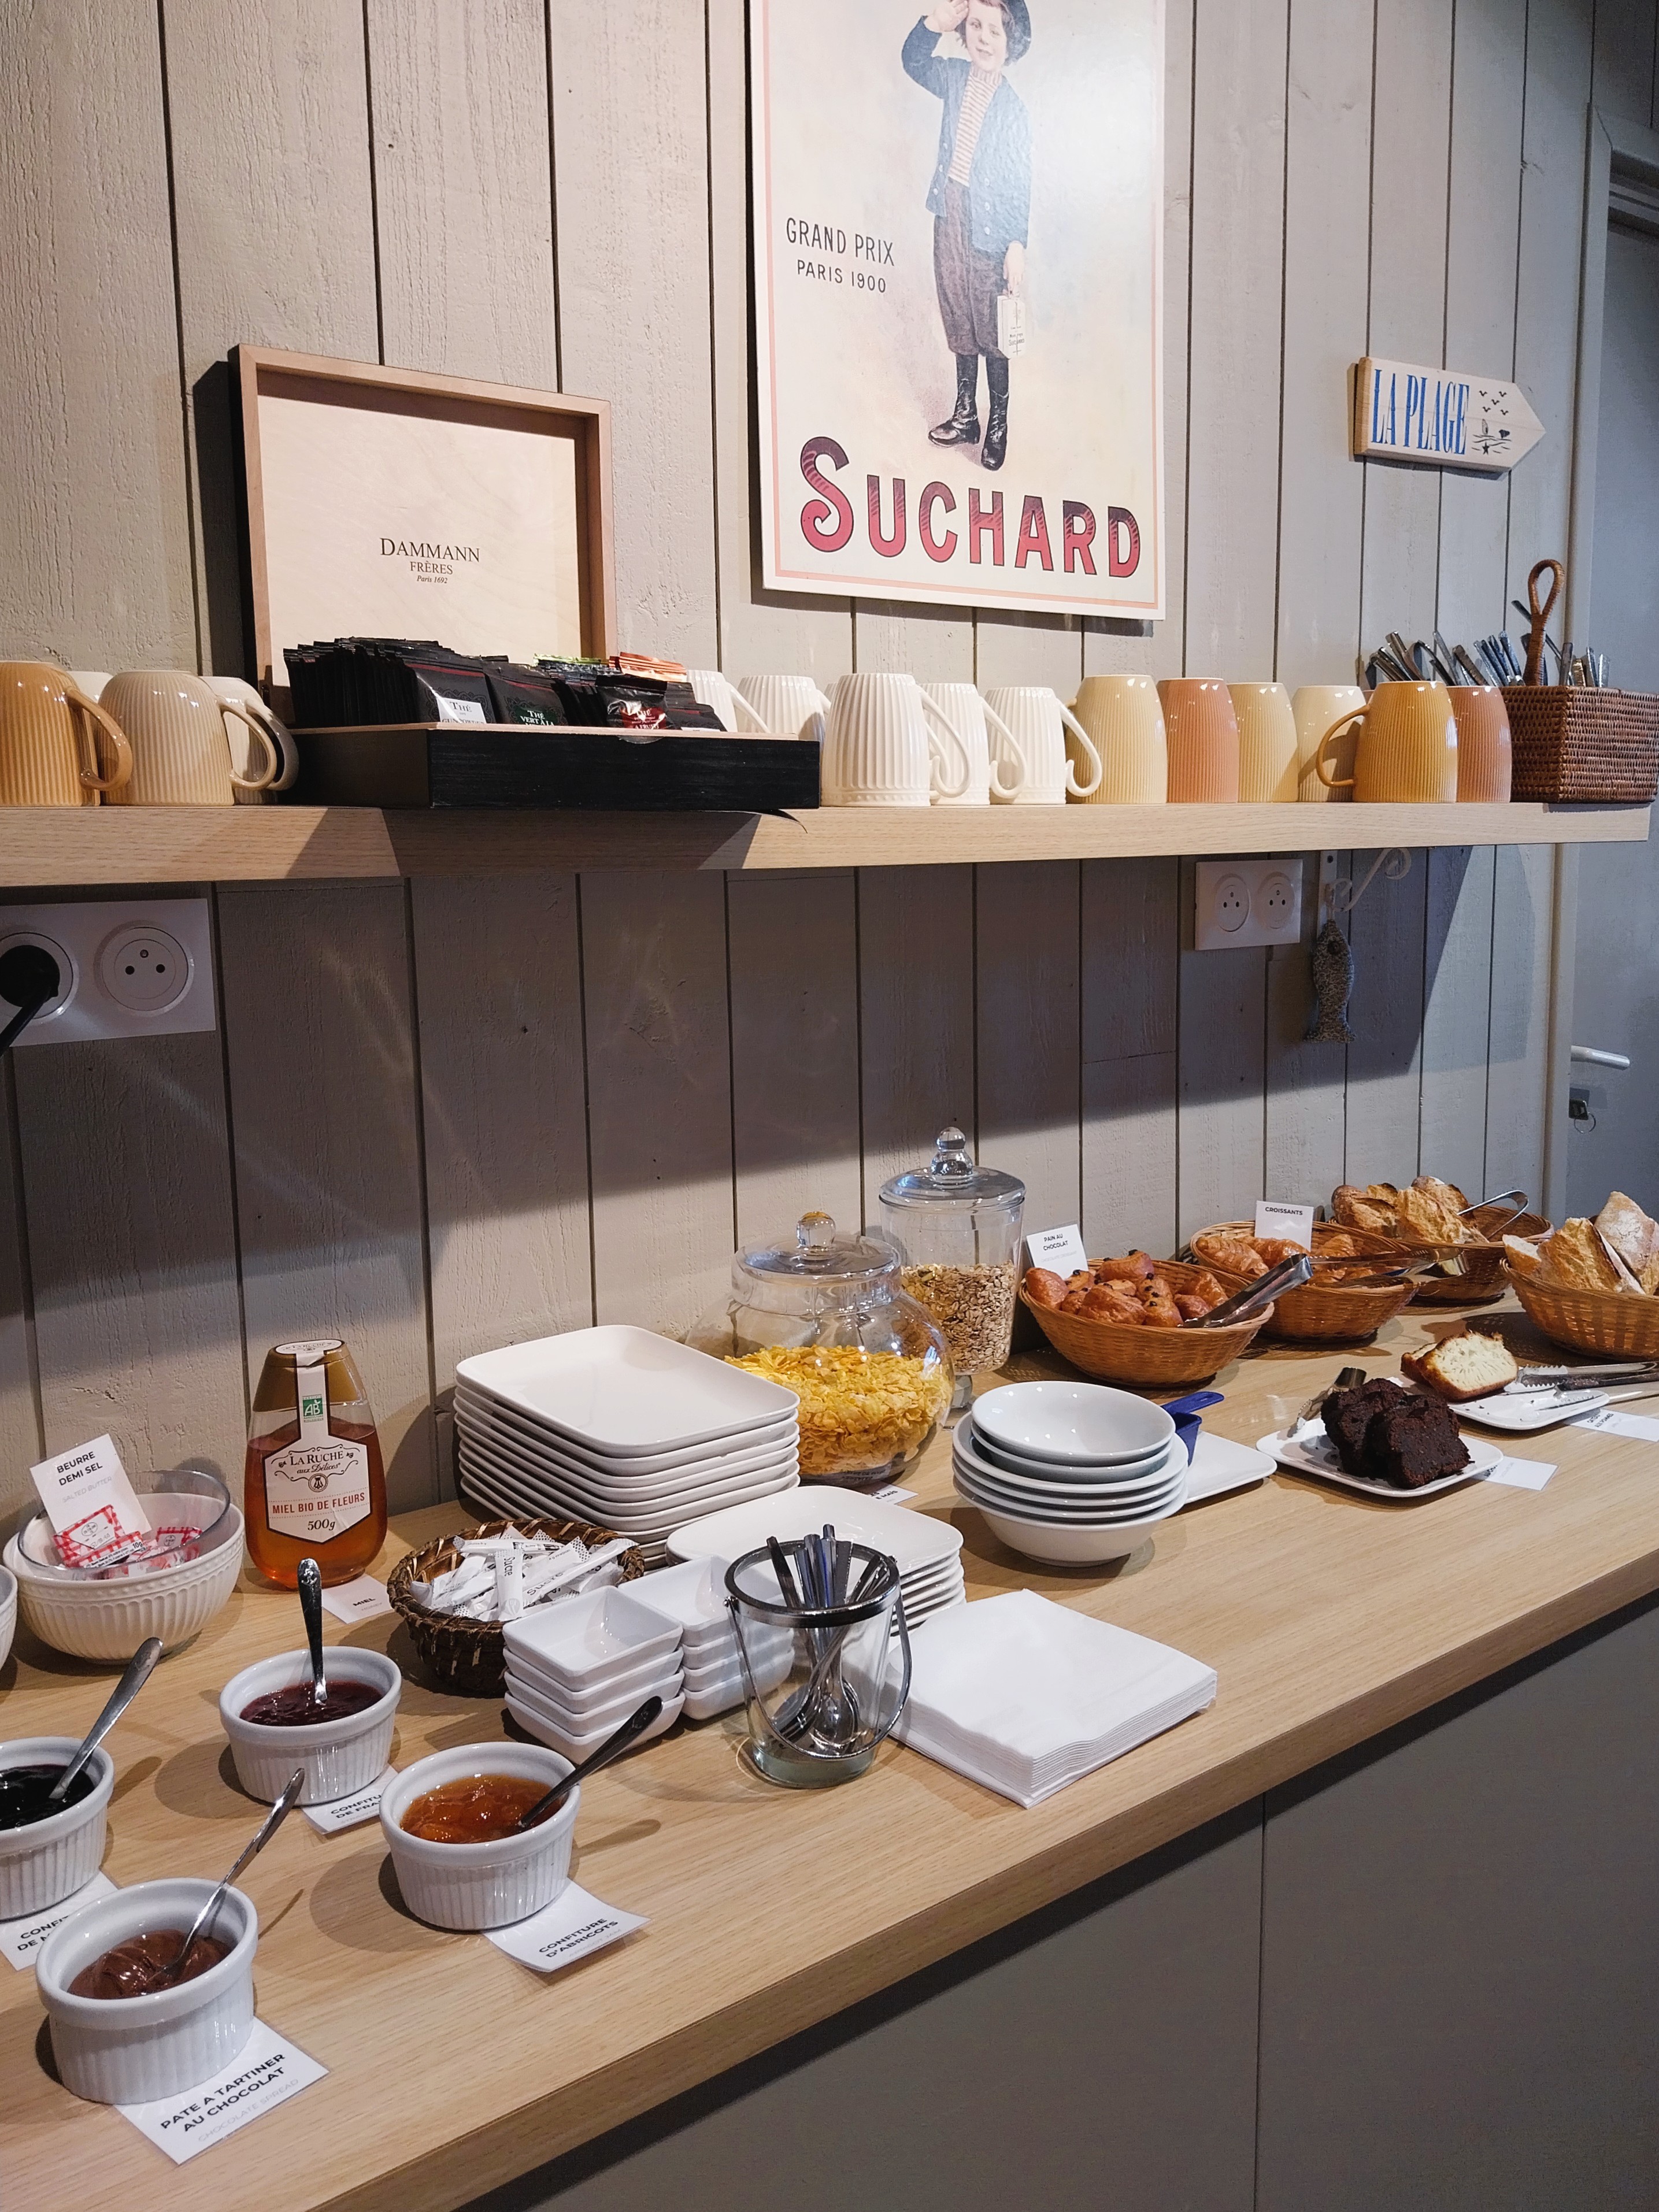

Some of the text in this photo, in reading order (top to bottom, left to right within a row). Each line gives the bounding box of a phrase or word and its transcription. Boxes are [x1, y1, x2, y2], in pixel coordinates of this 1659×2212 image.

[786, 217, 895, 266] GRAND PRIX
[797, 260, 887, 294] PARIS 1900
[1371, 369, 1470, 455] LA PLAGE
[800, 436, 1140, 578] SUCHARD
[379, 537, 481, 562] DAMMANN
[410, 560, 453, 575] FRÈRES
[416, 575, 432, 583] Paris
[450, 701, 472, 713] THÉ
[527, 710, 545, 720] THÉ
[520, 716, 539, 724] VERT
[1265, 1206, 1304, 1216] CROISSANTS
[1043, 1240, 1068, 1250] CHOCOLAT
[304, 1403, 321, 1416] AB
[57, 1451, 96, 1474] BEURRE
[290, 1450, 345, 1466] LA RUCHE
[58, 1461, 103, 1486] DEMI SEL
[62, 1476, 113, 1503] SALTED BUTTER
[272, 1492, 365, 1514] MIEL BIO DE FLEURS
[308, 1518, 336, 1531] 500g
[132, 1541, 143, 1549] 10g
[503, 1556, 516, 1577] Sucre
[527, 1572, 564, 1596] Sucre
[353, 1598, 376, 1606] MIEL
[331, 1794, 382, 1814] CONFITU
[335, 1811, 354, 1819] DE
[17, 1939, 38, 1951] DE
[539, 1918, 608, 1953] CONFITURE
[545, 1921, 619, 1958] D'ABRICOTS
[161, 2054, 286, 2129] PATE A TARTINER
[183, 2066, 285, 2132] AU CHOCOLAT
[198, 2078, 299, 2142] CHOCOLATE SPREAD
